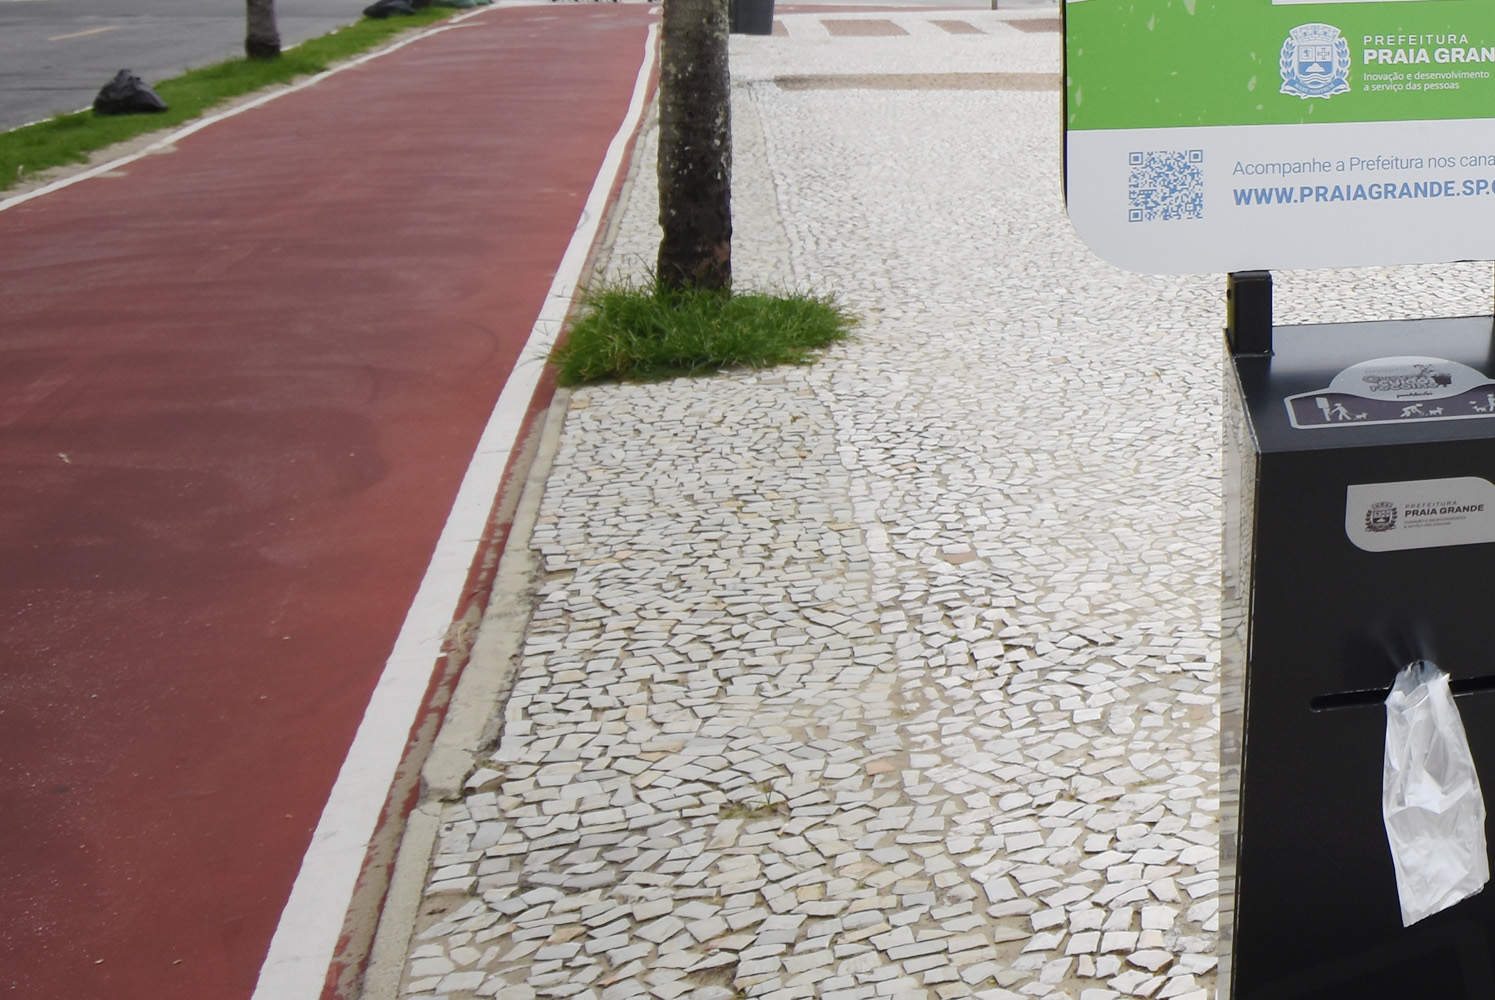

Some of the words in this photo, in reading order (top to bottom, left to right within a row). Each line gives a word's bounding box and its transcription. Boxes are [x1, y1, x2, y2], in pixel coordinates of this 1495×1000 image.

[1363, 34, 1469, 46] PREFEITURA
[1363, 48, 1430, 65] PRAIA
[1363, 72, 1404, 83] Inovação
[1406, 73, 1412, 81] e
[1414, 70, 1490, 80] desenvolvimento
[1363, 84, 1370, 92] a
[1371, 81, 1403, 92] serviço
[1405, 81, 1421, 91] das
[1424, 81, 1459, 91] pessoas
[1233, 157, 1332, 177] Acompanhe
[1336, 161, 1345, 172] a
[1349, 153, 1424, 171] Prefeitura
[1428, 156, 1456, 168] nos
[1405, 508, 1437, 517] PRAIA
[1439, 504, 1484, 514] GRANDE
